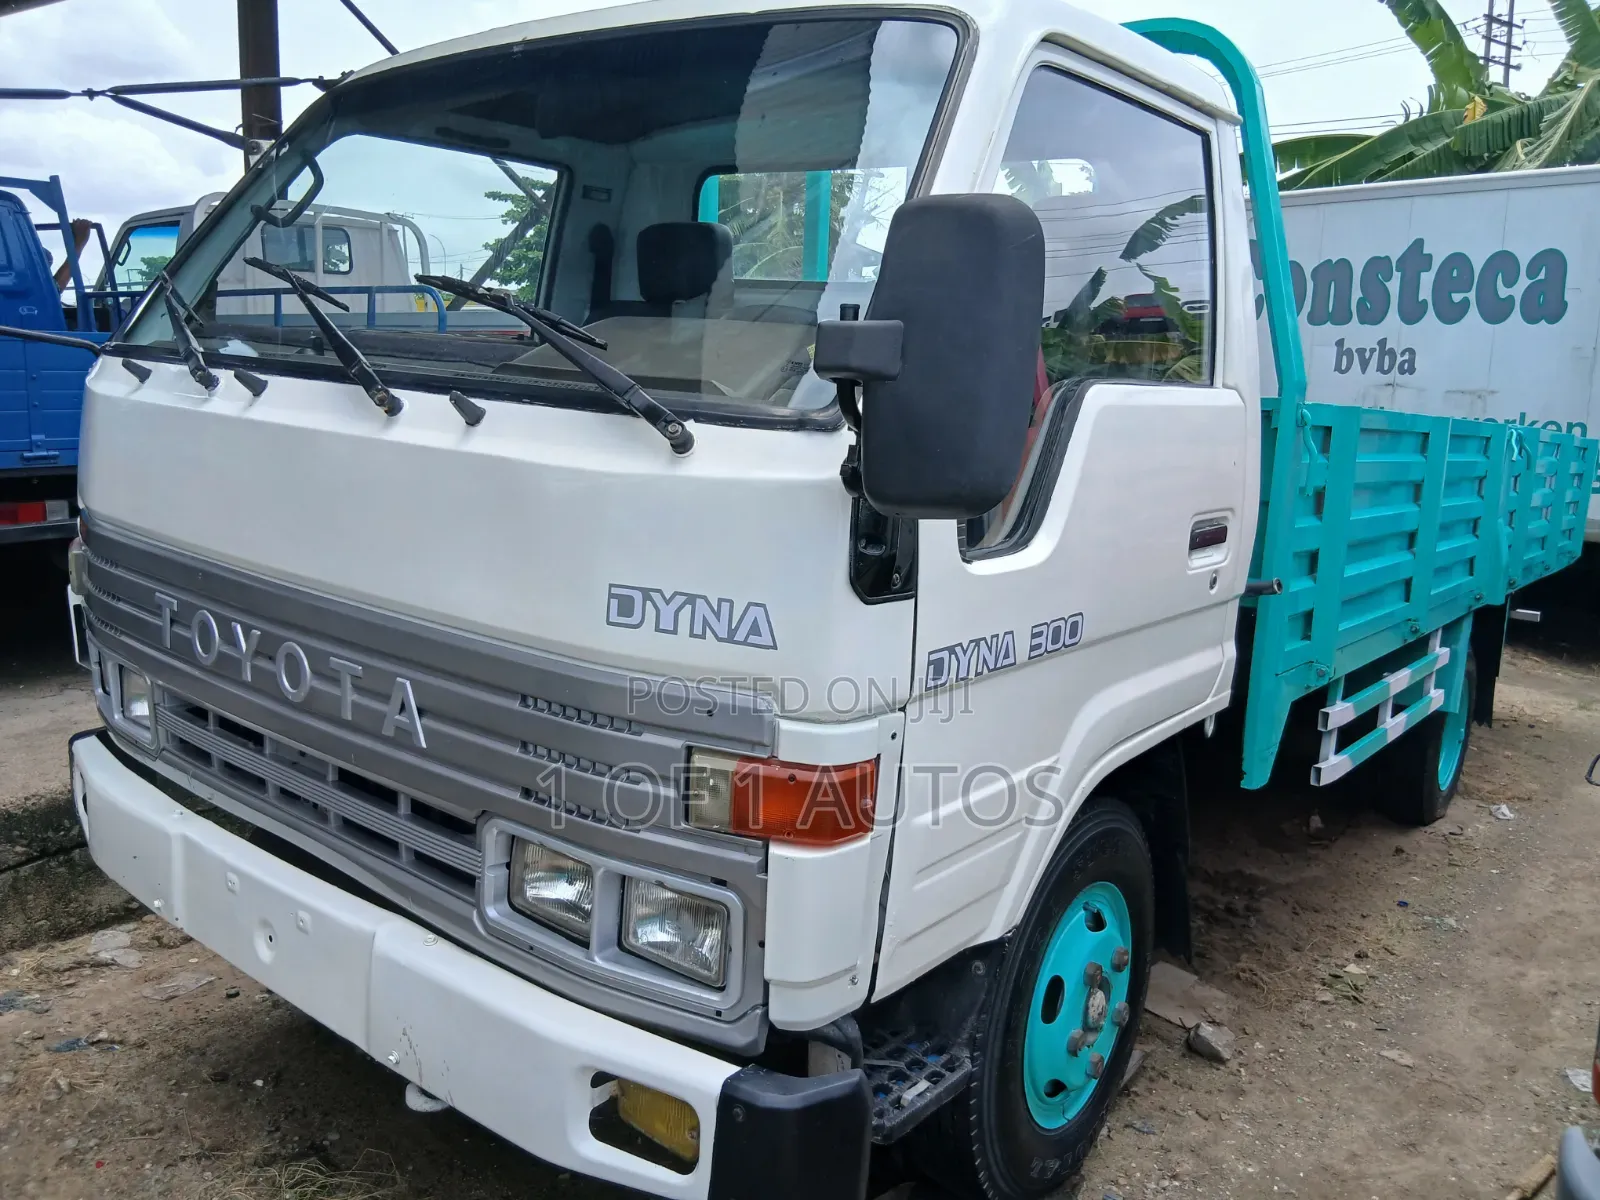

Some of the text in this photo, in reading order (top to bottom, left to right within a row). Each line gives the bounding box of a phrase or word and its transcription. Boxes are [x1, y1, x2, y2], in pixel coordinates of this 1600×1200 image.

[1334, 338, 1417, 375] bvba
[606, 583, 778, 650] DYNA
[925, 612, 1084, 691] DYNA 300
[155, 592, 427, 749] TOYOTA
